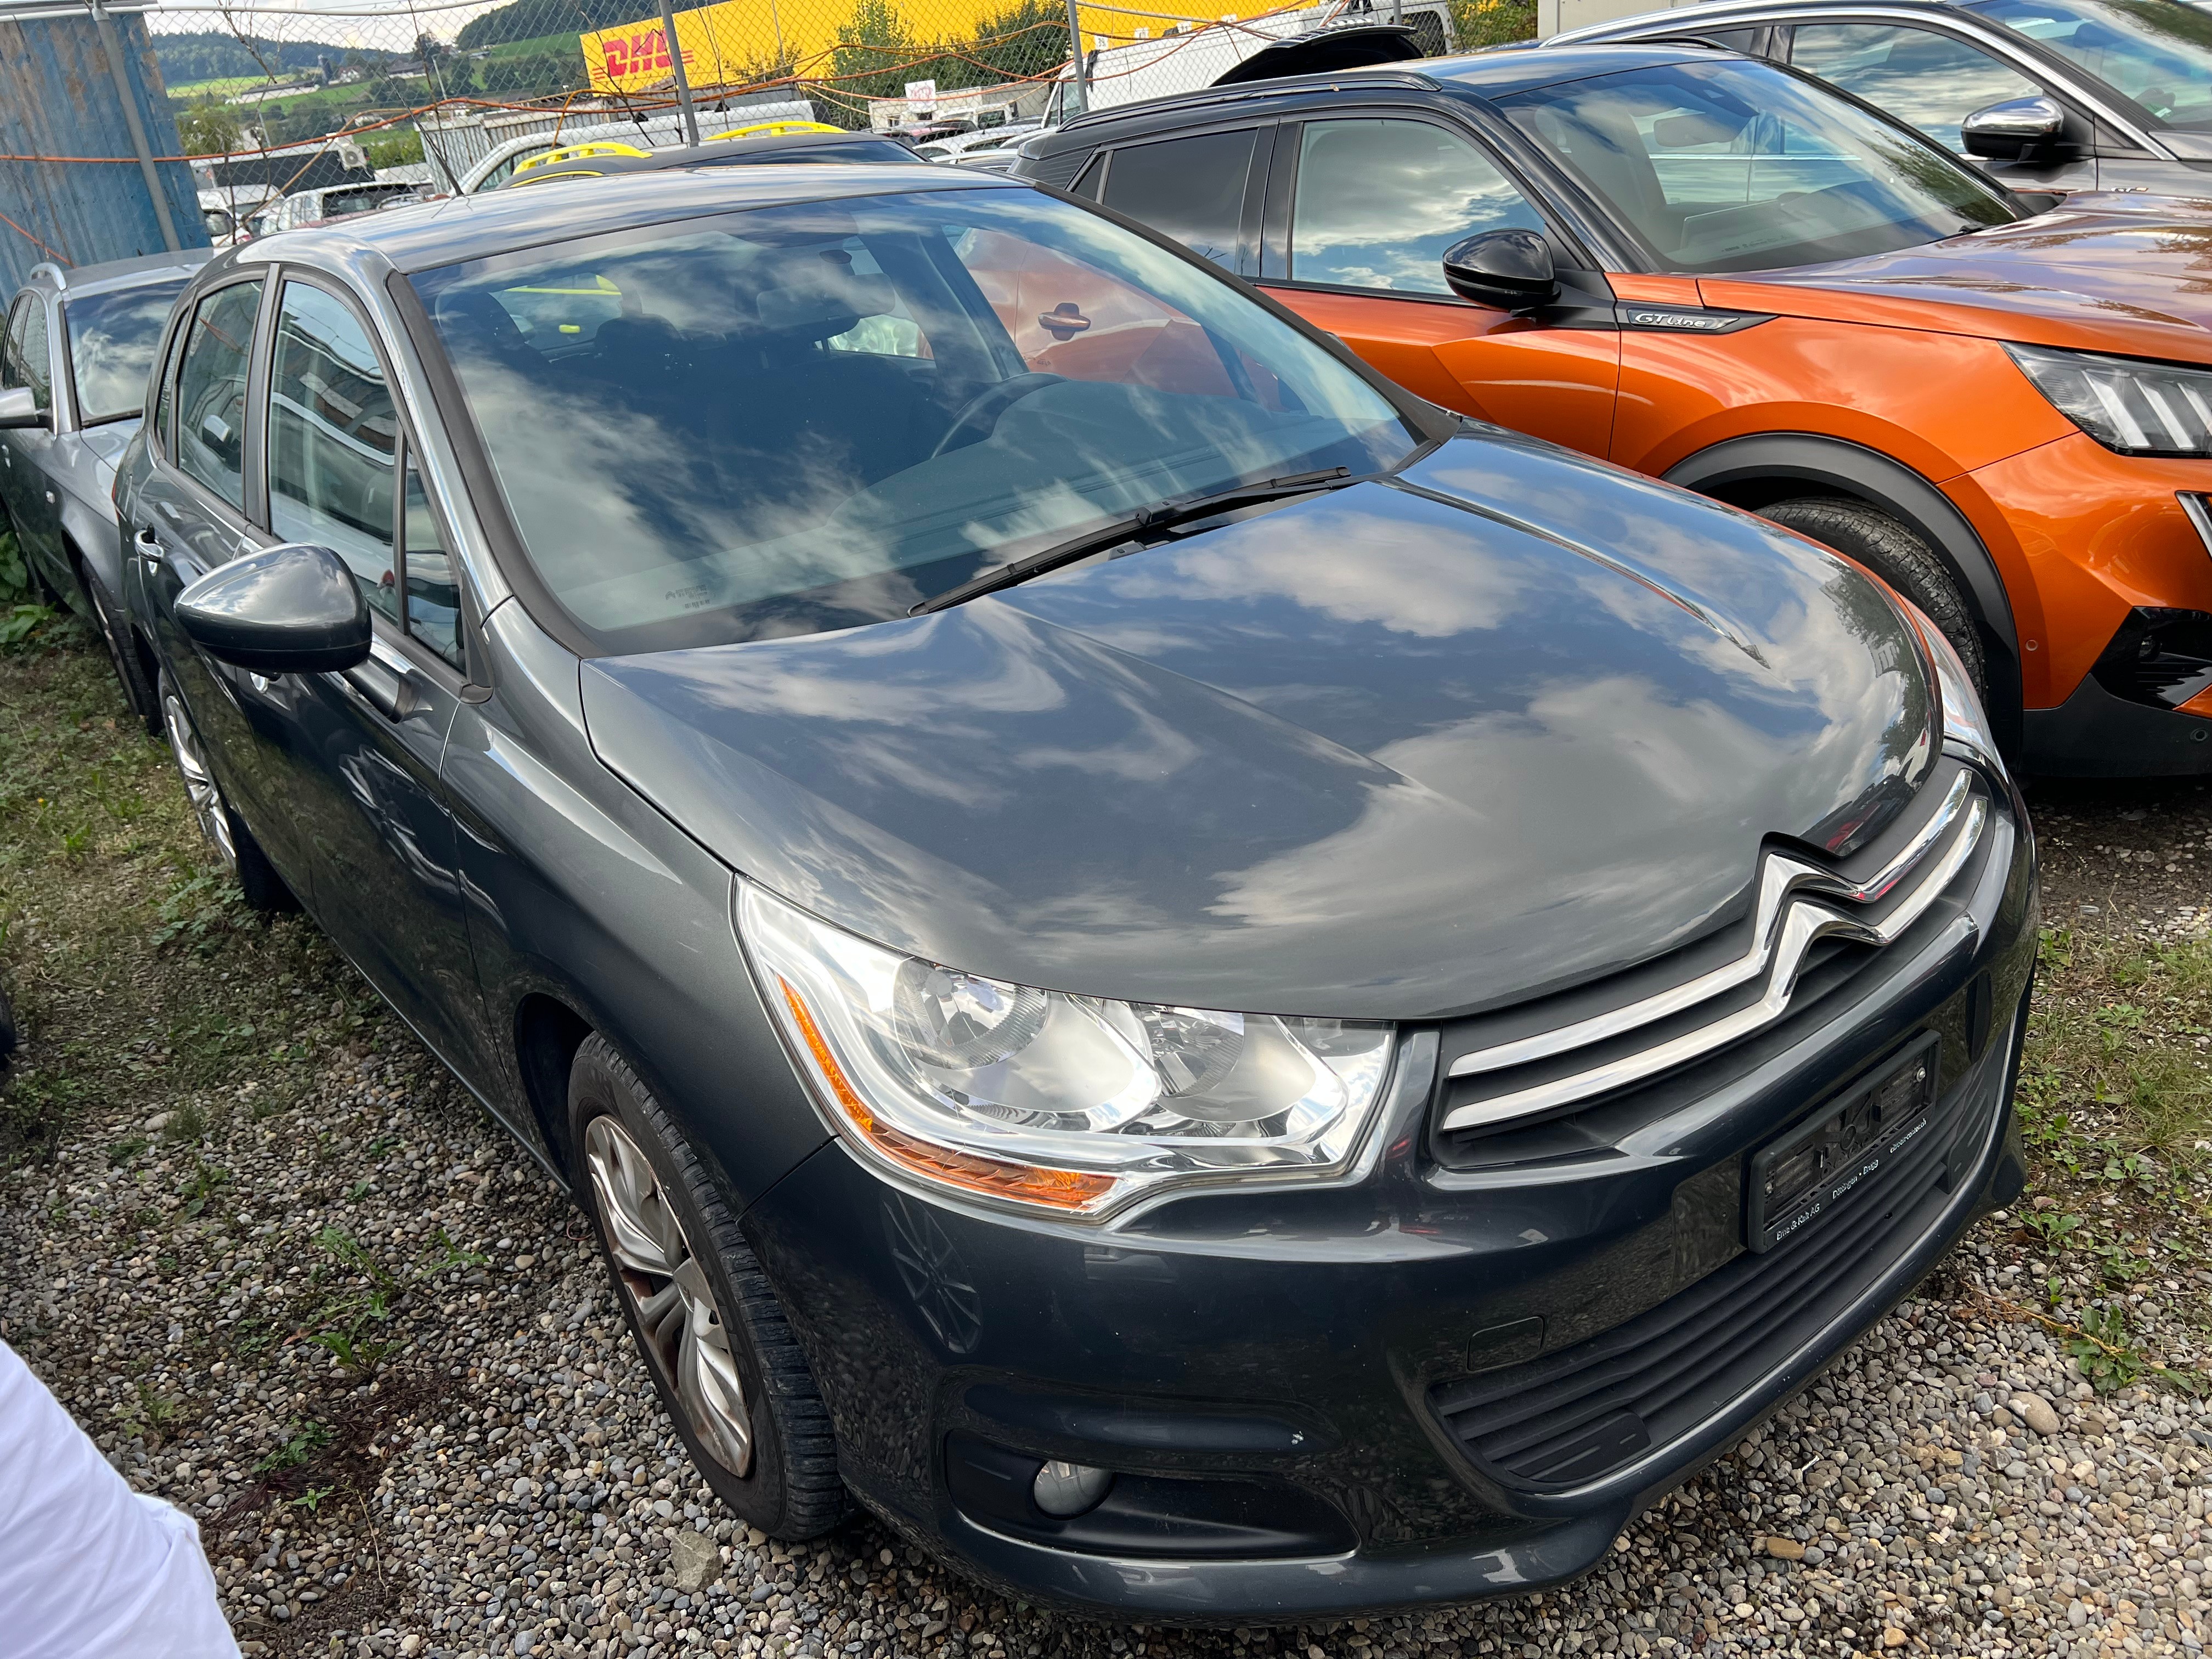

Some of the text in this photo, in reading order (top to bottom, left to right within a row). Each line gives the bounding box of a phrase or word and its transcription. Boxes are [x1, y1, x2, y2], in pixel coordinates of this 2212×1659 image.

[603, 27, 674, 77] DHL
[1635, 313, 1668, 324] GT
[1810, 1203, 1820, 1217] AG
